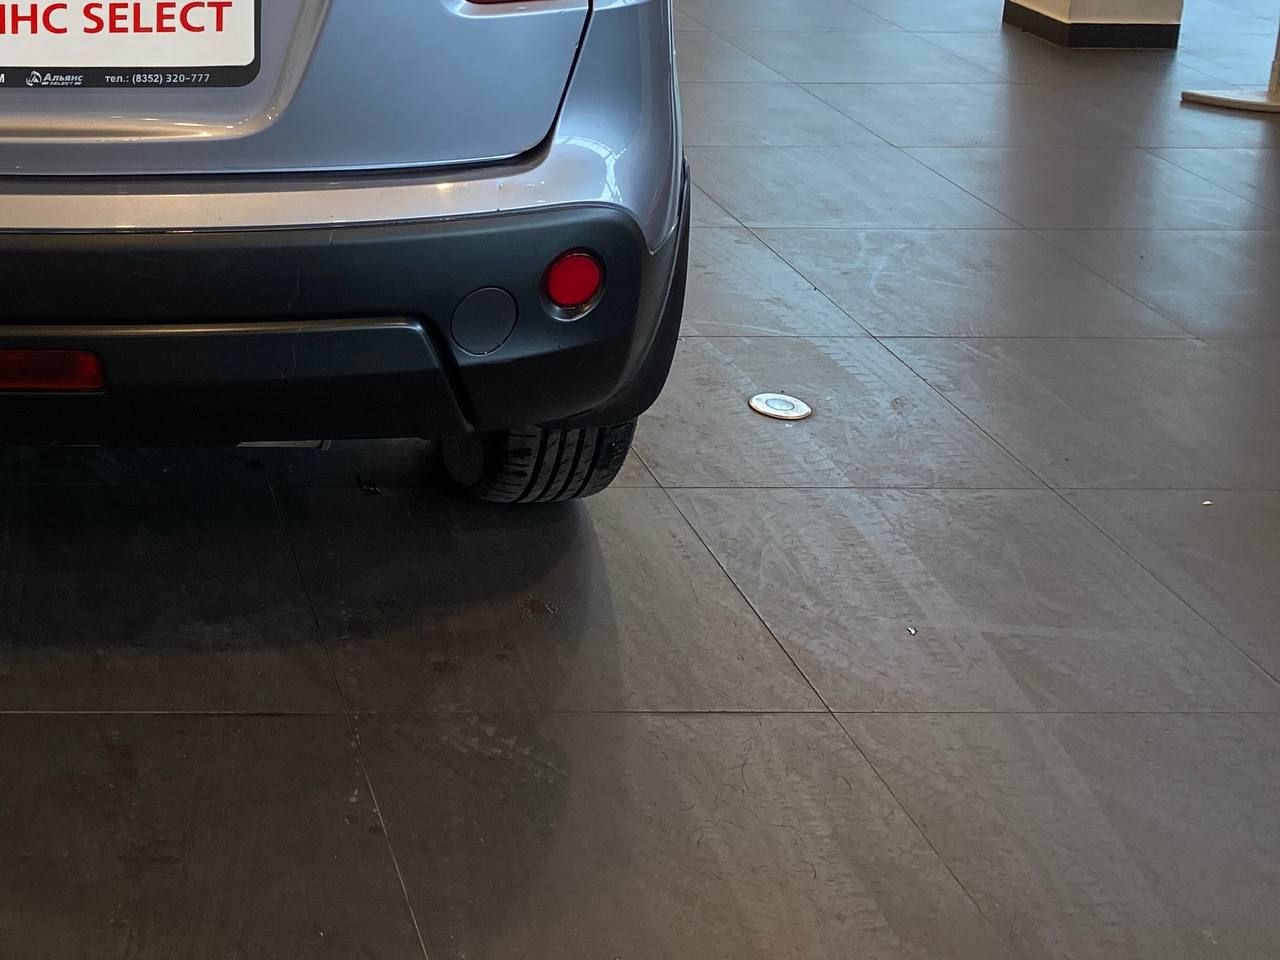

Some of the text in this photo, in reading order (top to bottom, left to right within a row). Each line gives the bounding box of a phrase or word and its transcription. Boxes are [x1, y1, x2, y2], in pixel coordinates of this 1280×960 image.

[83, 1, 233, 34] SELECT
[105, 73, 210, 84] тел.: (8352) 320-777
